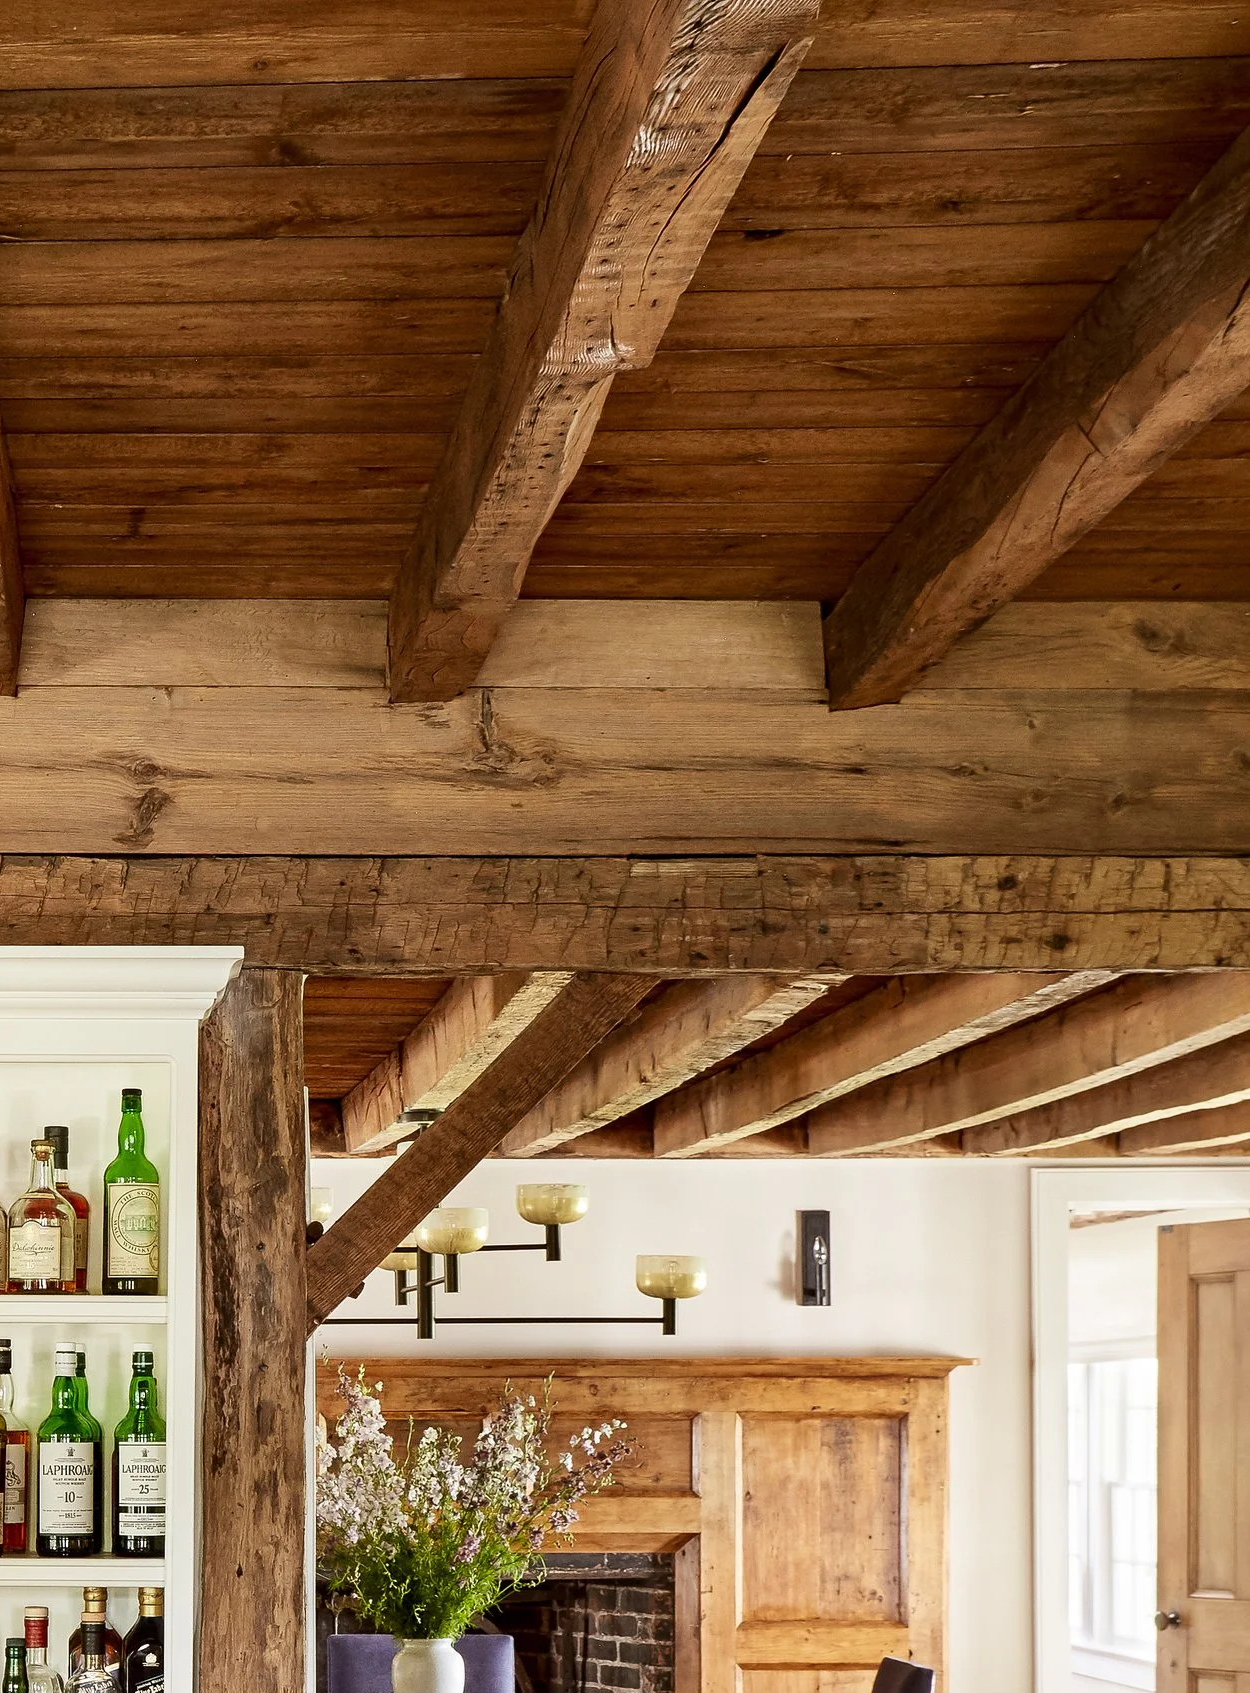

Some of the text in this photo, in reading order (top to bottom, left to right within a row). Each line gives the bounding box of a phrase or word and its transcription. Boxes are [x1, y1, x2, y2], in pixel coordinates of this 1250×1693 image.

[122, 1464, 166, 1473] LAPHROAIG
[139, 1484, 150, 1494] 25
[64, 1491, 75, 1503] 10
